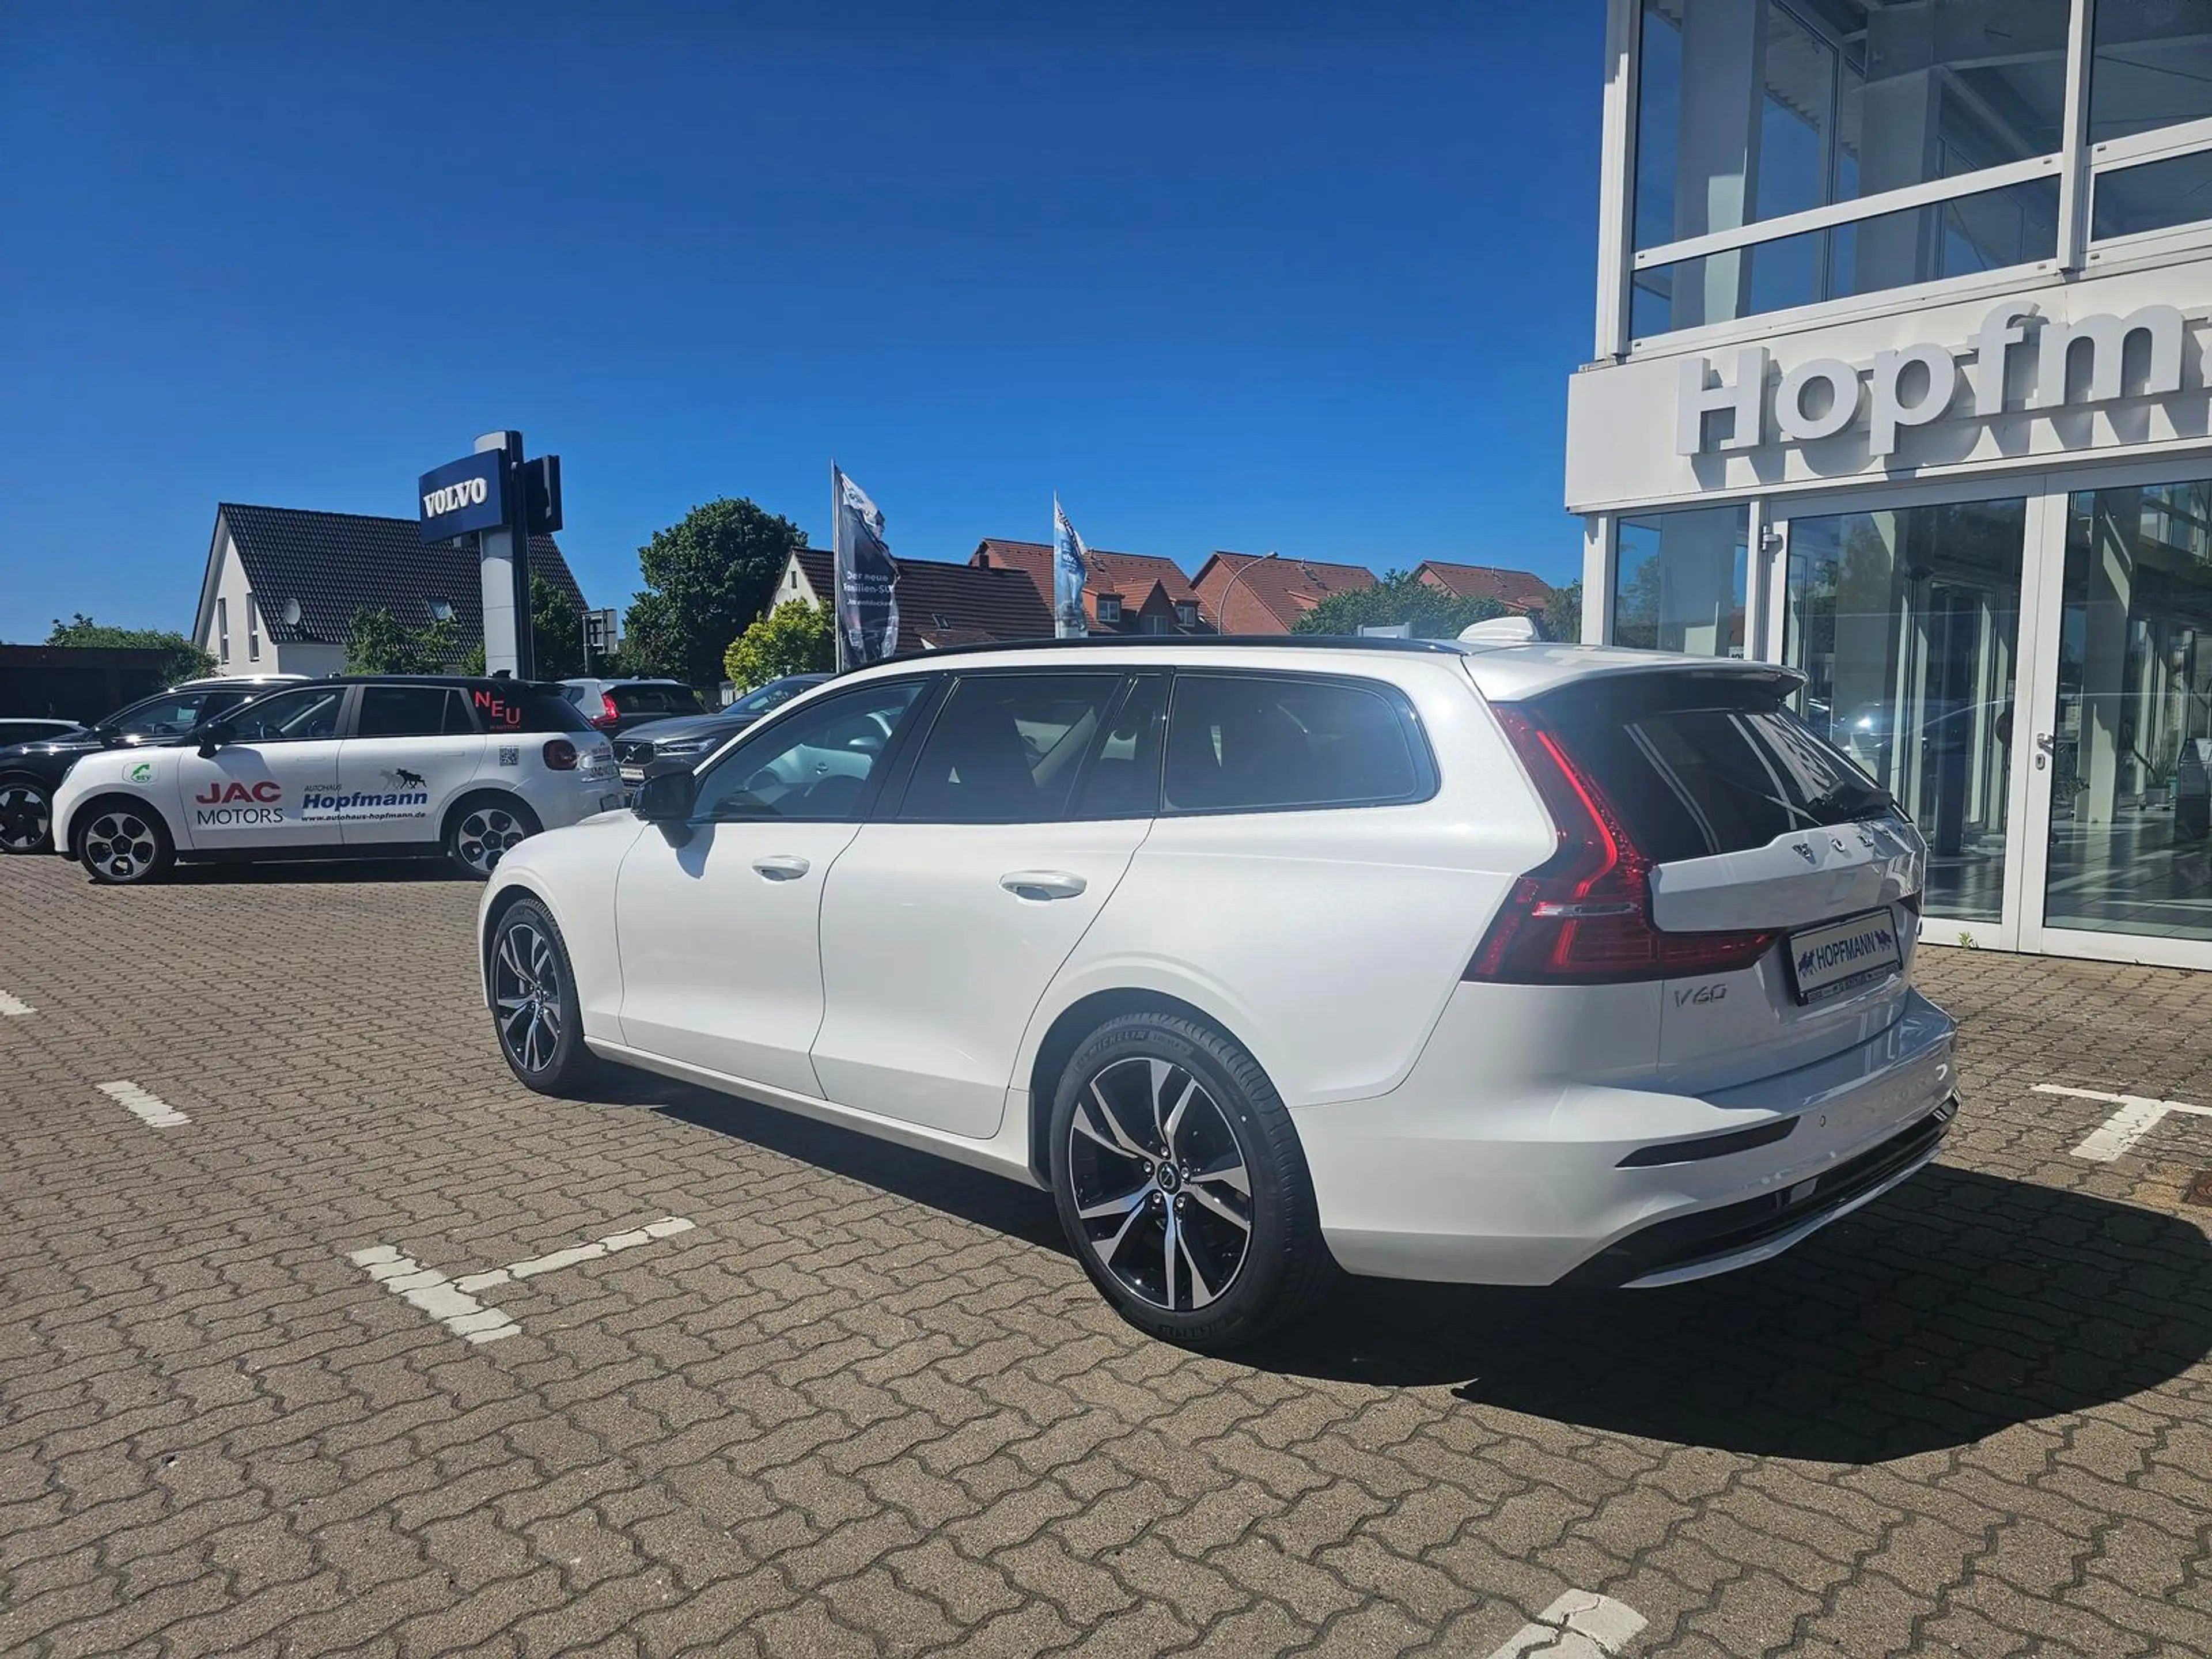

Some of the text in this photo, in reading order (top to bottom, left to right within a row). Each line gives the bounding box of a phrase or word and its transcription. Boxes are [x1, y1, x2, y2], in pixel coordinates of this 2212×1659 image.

[1677, 301, 2212, 456] Hopfm
[423, 477, 487, 518] VOLVO
[475, 691, 520, 724] NEU
[196, 781, 282, 804] JAC
[302, 791, 427, 812] Hopfmann
[197, 808, 283, 824] MOTORS
[301, 812, 426, 821] www.autohaus-hopfmann.de
[1816, 931, 1876, 969] HOPFMANN
[1674, 984, 1727, 1007] V60
